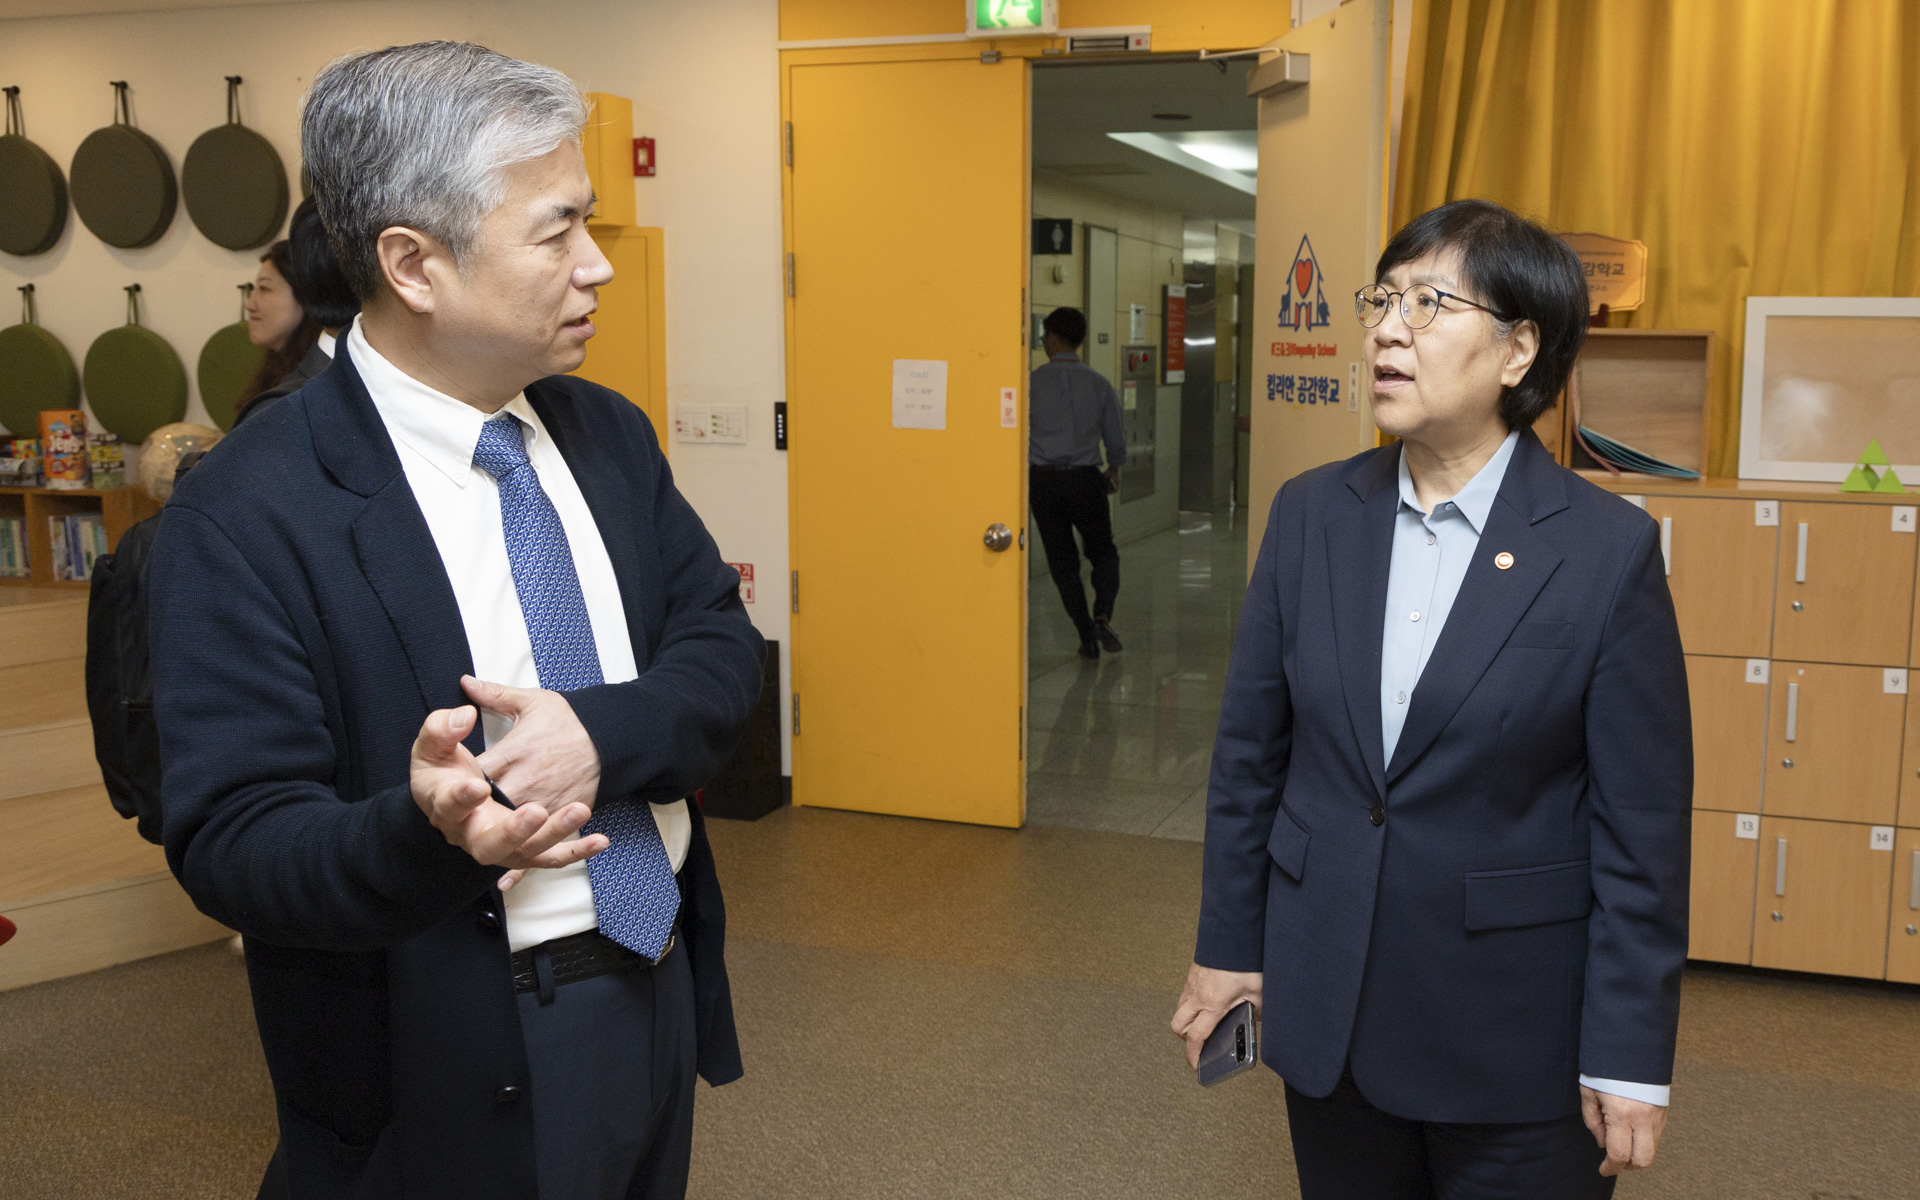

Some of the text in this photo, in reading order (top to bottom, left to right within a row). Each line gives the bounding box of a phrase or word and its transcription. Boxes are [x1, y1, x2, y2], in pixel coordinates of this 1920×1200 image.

[1267, 373, 1295, 402] 킬리안
[1297, 376, 1340, 405] 공감학교
[1763, 507, 1771, 518] 3
[1900, 514, 1908, 523] 4
[1753, 665, 1761, 676] 8
[1891, 677, 1900, 687] 9
[1742, 821, 1754, 832] 13
[1876, 833, 1888, 842] 14
